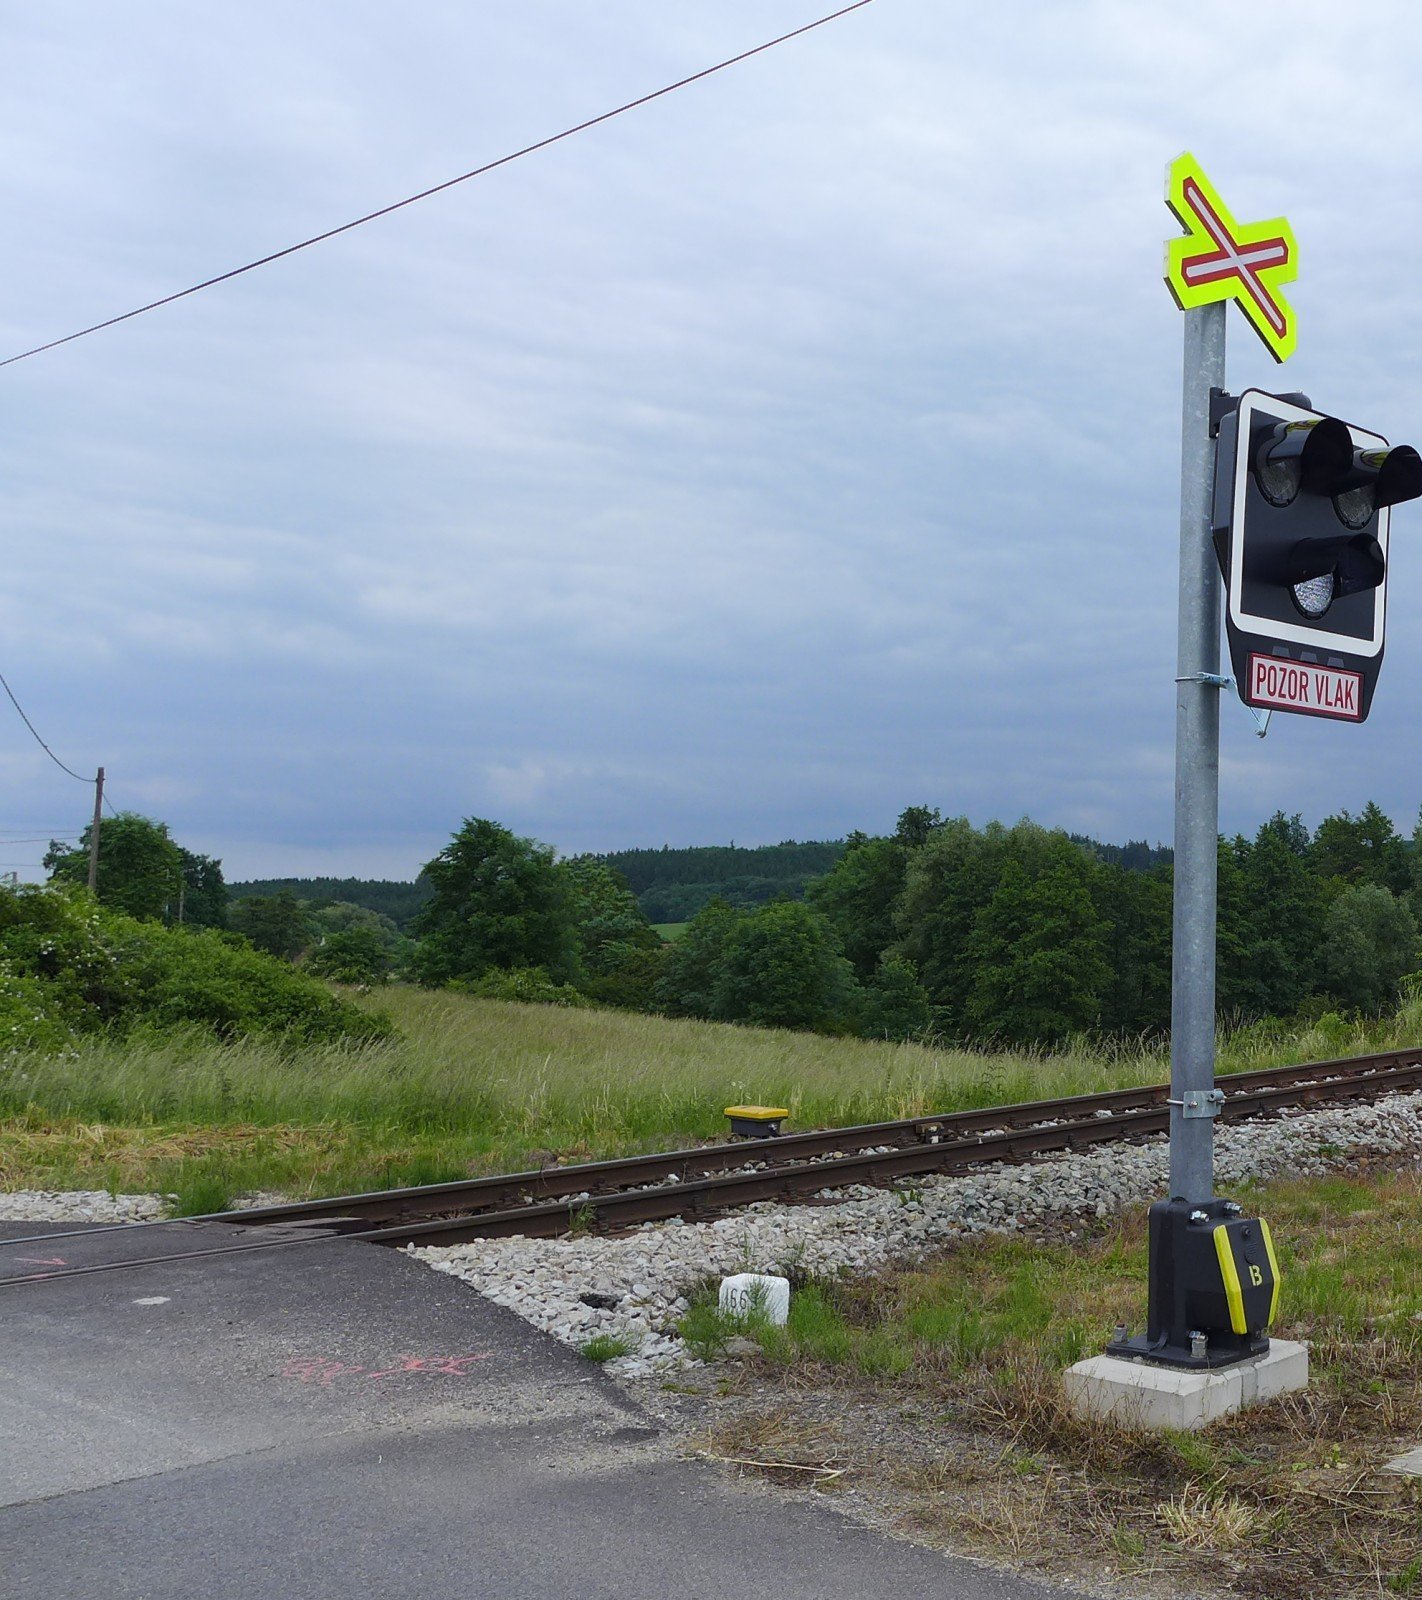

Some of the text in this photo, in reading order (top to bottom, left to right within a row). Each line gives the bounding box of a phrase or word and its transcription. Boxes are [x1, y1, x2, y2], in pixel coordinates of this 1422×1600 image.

[1256, 662, 1355, 711] POZOR VLAK
[1248, 1264, 1263, 1287] B
